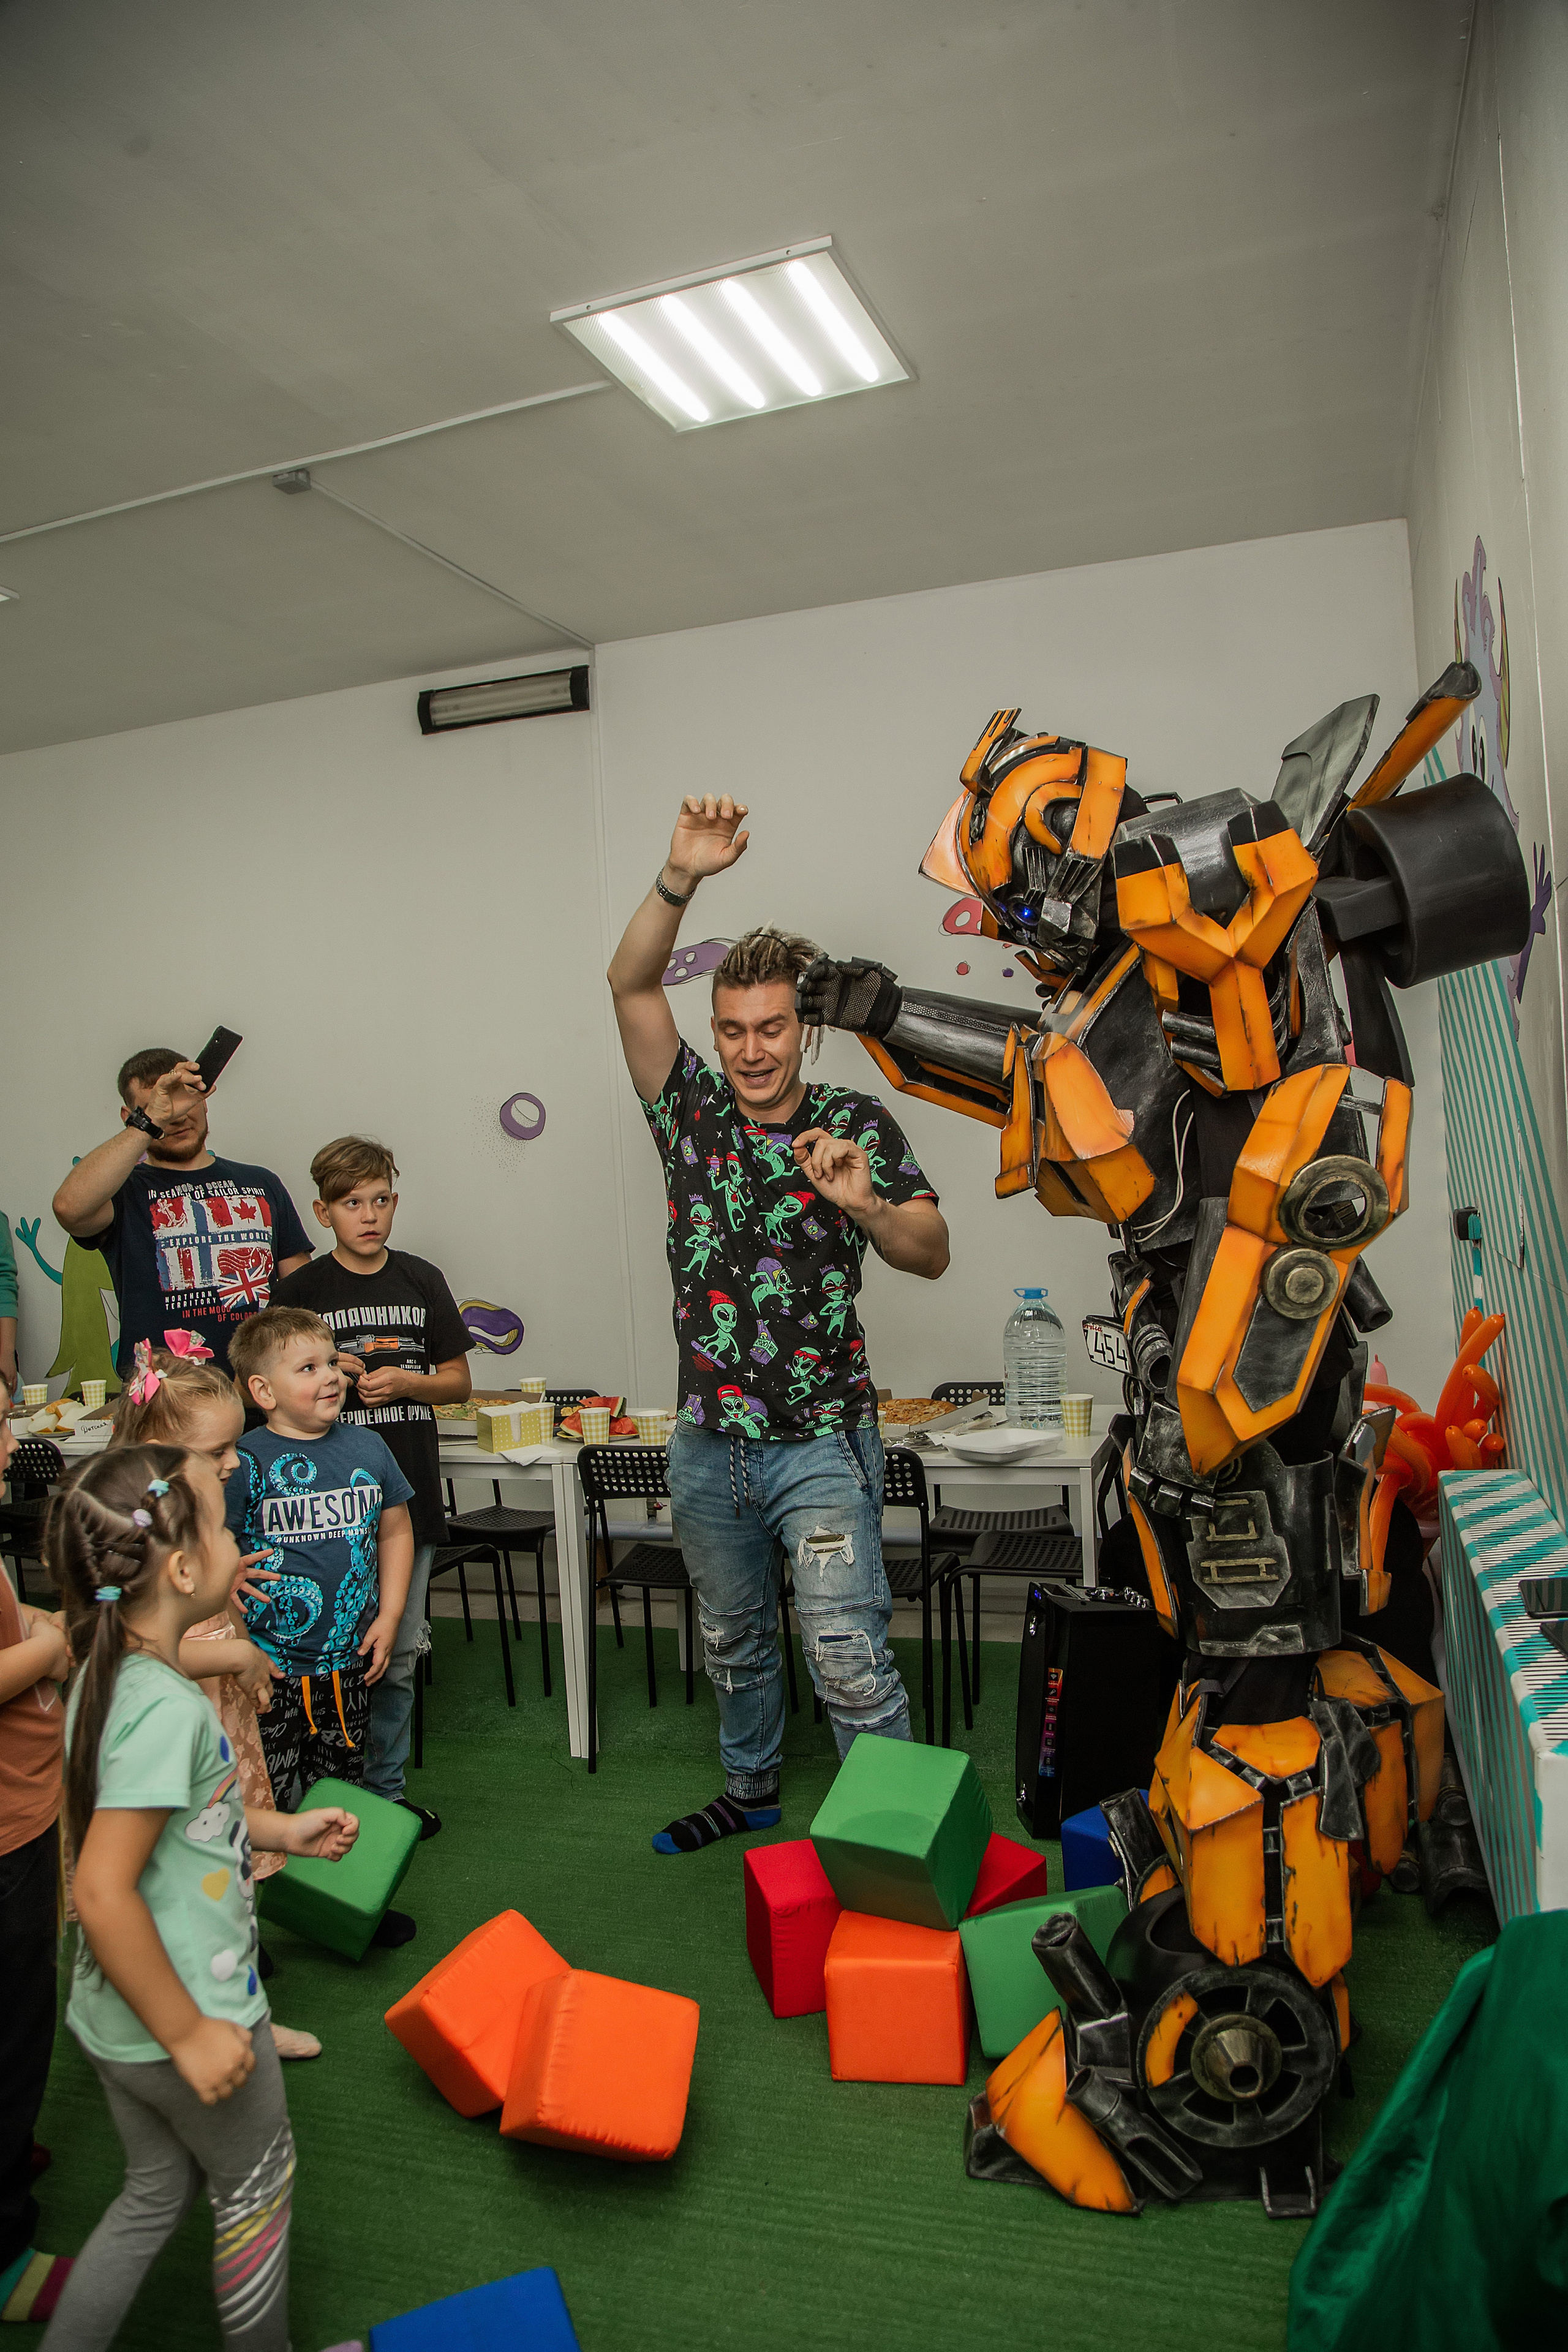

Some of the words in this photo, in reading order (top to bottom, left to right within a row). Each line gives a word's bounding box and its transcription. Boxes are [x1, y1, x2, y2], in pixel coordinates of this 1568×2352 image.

[206, 1180, 235, 1190] OCEAN
[148, 1189, 157, 1200] IN
[194, 1190, 205, 1200] OF
[208, 1186, 239, 1197] SAILOR
[241, 1186, 266, 1196] SPIRIT
[169, 1235, 212, 1246] EXPLORE
[217, 1234, 235, 1242] THE
[165, 1291, 212, 1303] NORTHERN
[165, 1297, 217, 1310] TERRITORY
[193, 1308, 207, 1317] THE
[217, 1314, 227, 1322] OF
[317, 1305, 426, 1330] АЛАШНИКОВ
[336, 1406, 405, 1426] ЕРШЕННОЕ
[678, 1410, 690, 1420] 2020
[276, 1532, 326, 1544] #UNKNOWN
[328, 1529, 345, 1539] DEEP
